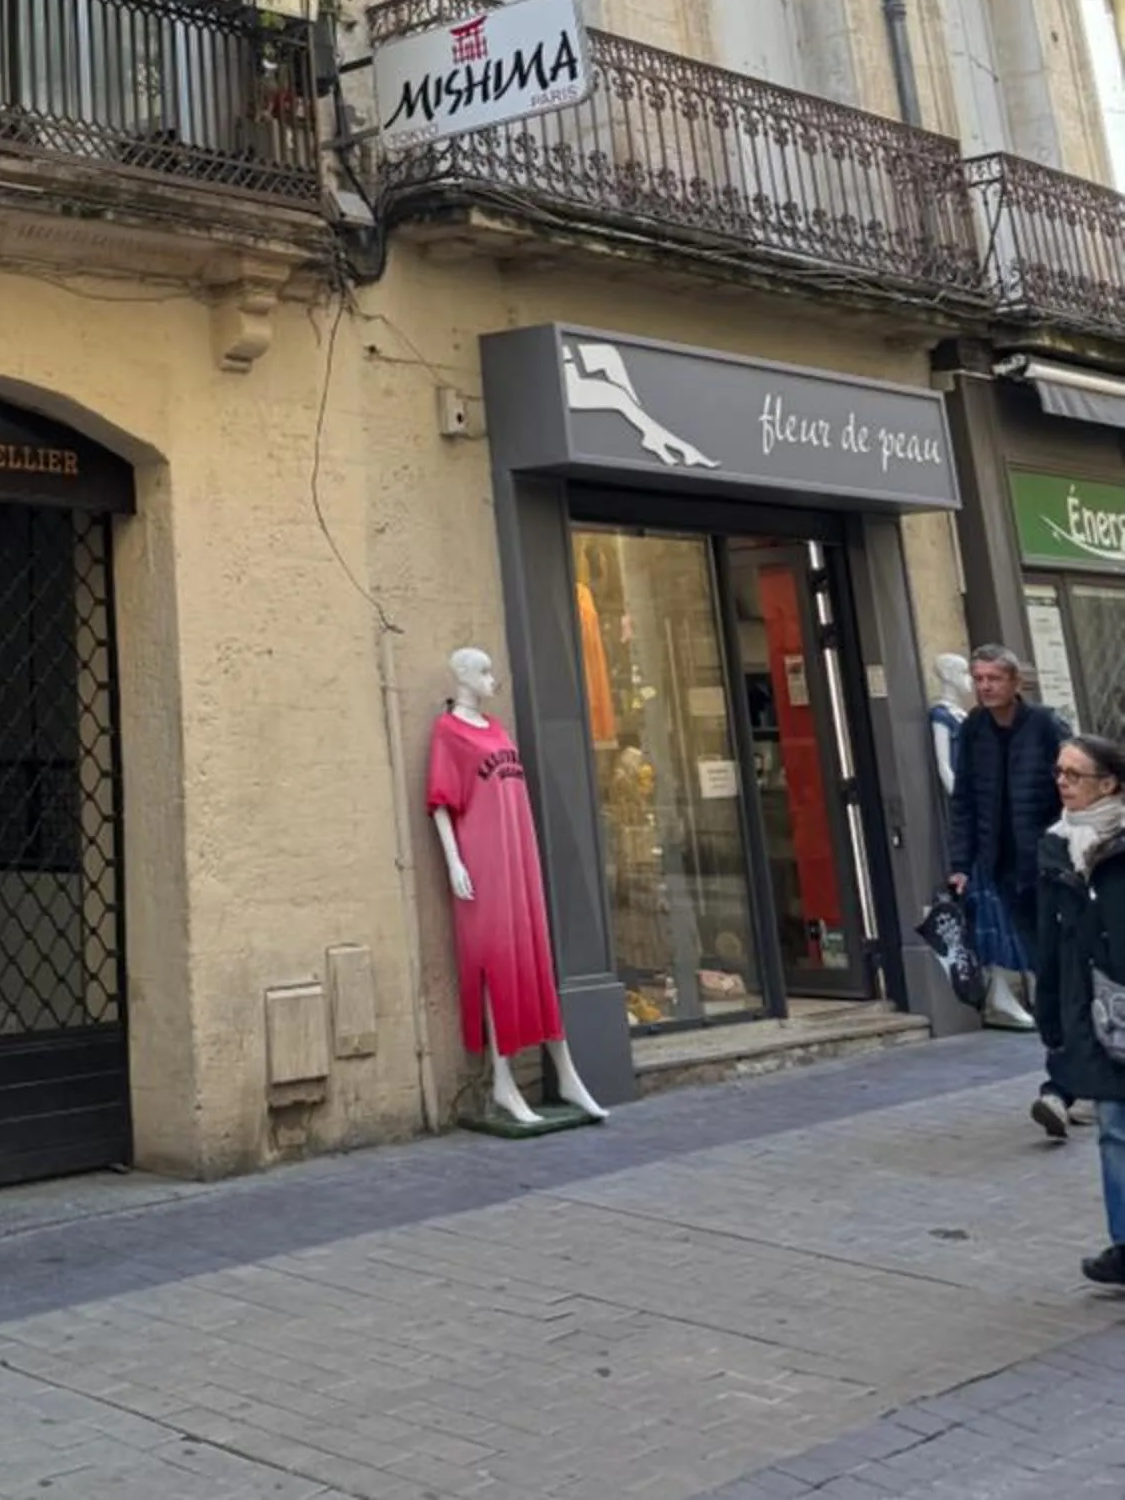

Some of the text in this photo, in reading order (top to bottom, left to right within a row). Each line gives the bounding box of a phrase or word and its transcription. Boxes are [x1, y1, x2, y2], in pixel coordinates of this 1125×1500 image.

[383, 29, 579, 130] MISHIMA
[758, 392, 943, 474] fleur de peau
